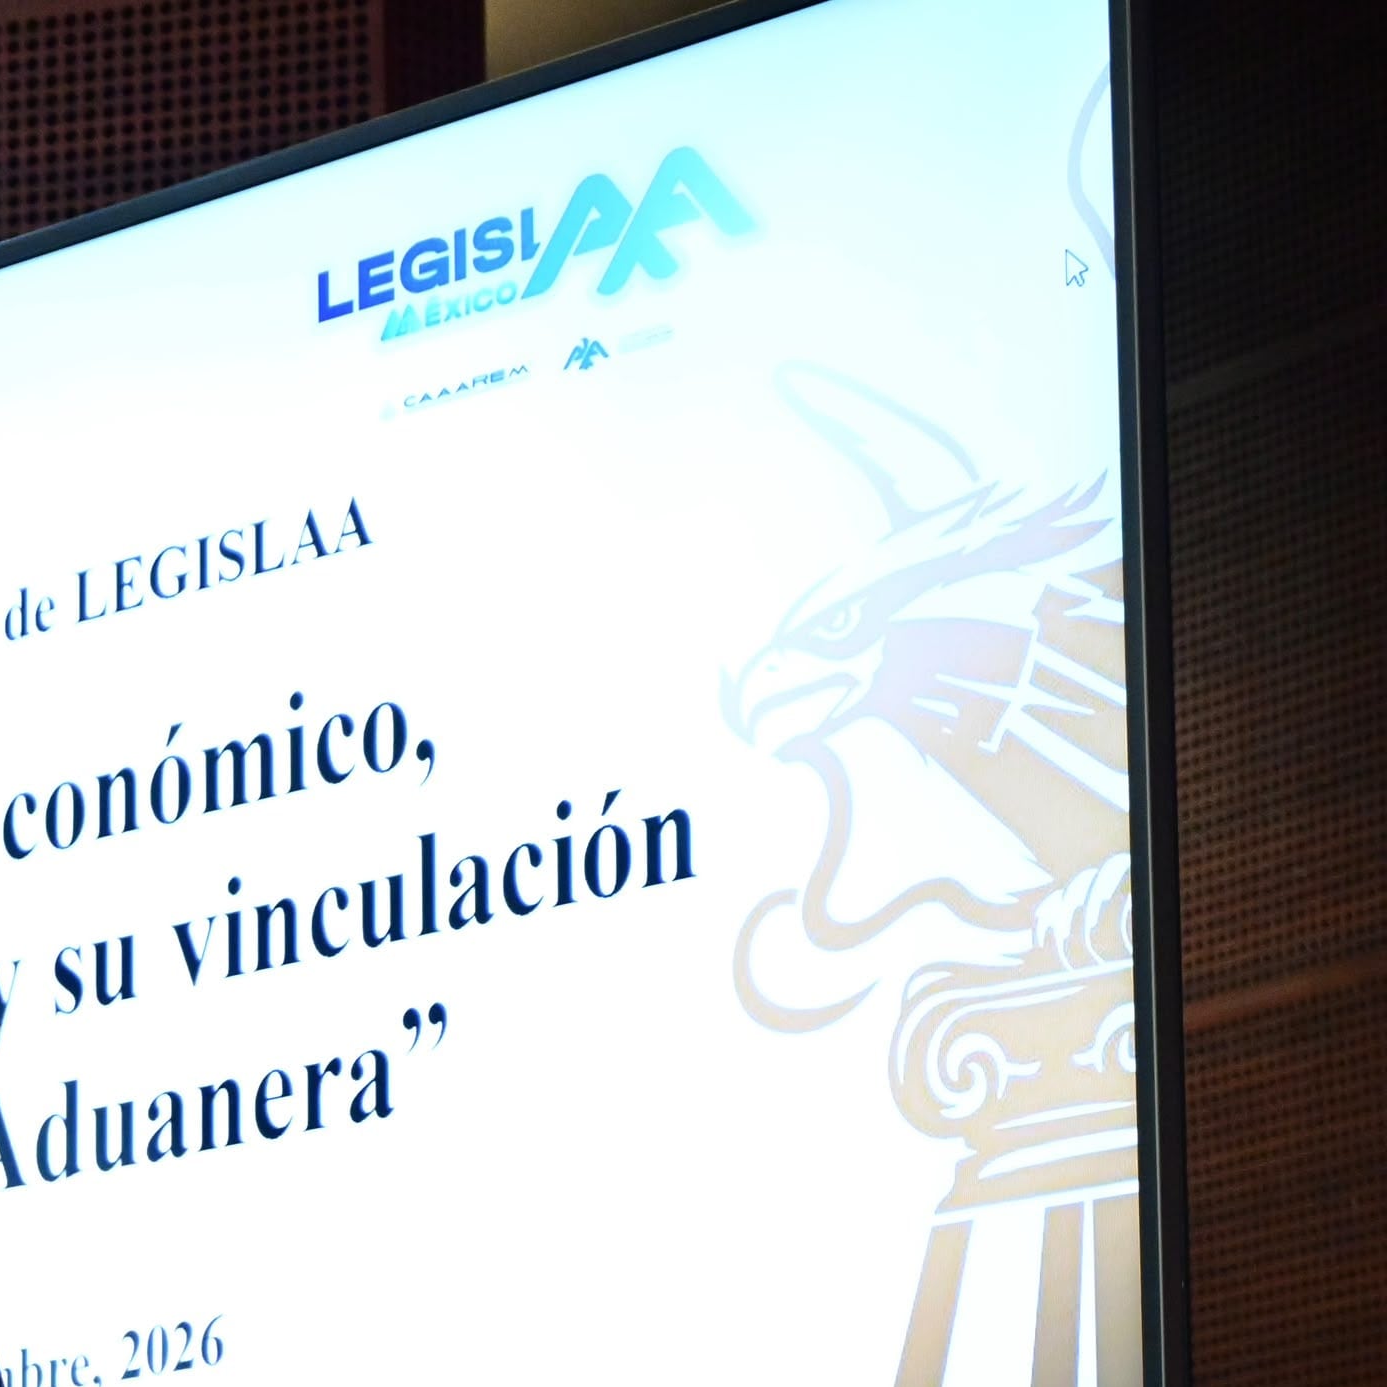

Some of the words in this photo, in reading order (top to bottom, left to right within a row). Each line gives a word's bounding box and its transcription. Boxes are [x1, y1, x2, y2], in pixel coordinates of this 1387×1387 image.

[4, 588, 56, 641] de
[76, 497, 373, 623] LEGISLAA
[54, 934, 136, 1016] su
[173, 789, 696, 988] vinculación
[121, 1313, 225, 1380] 2026
